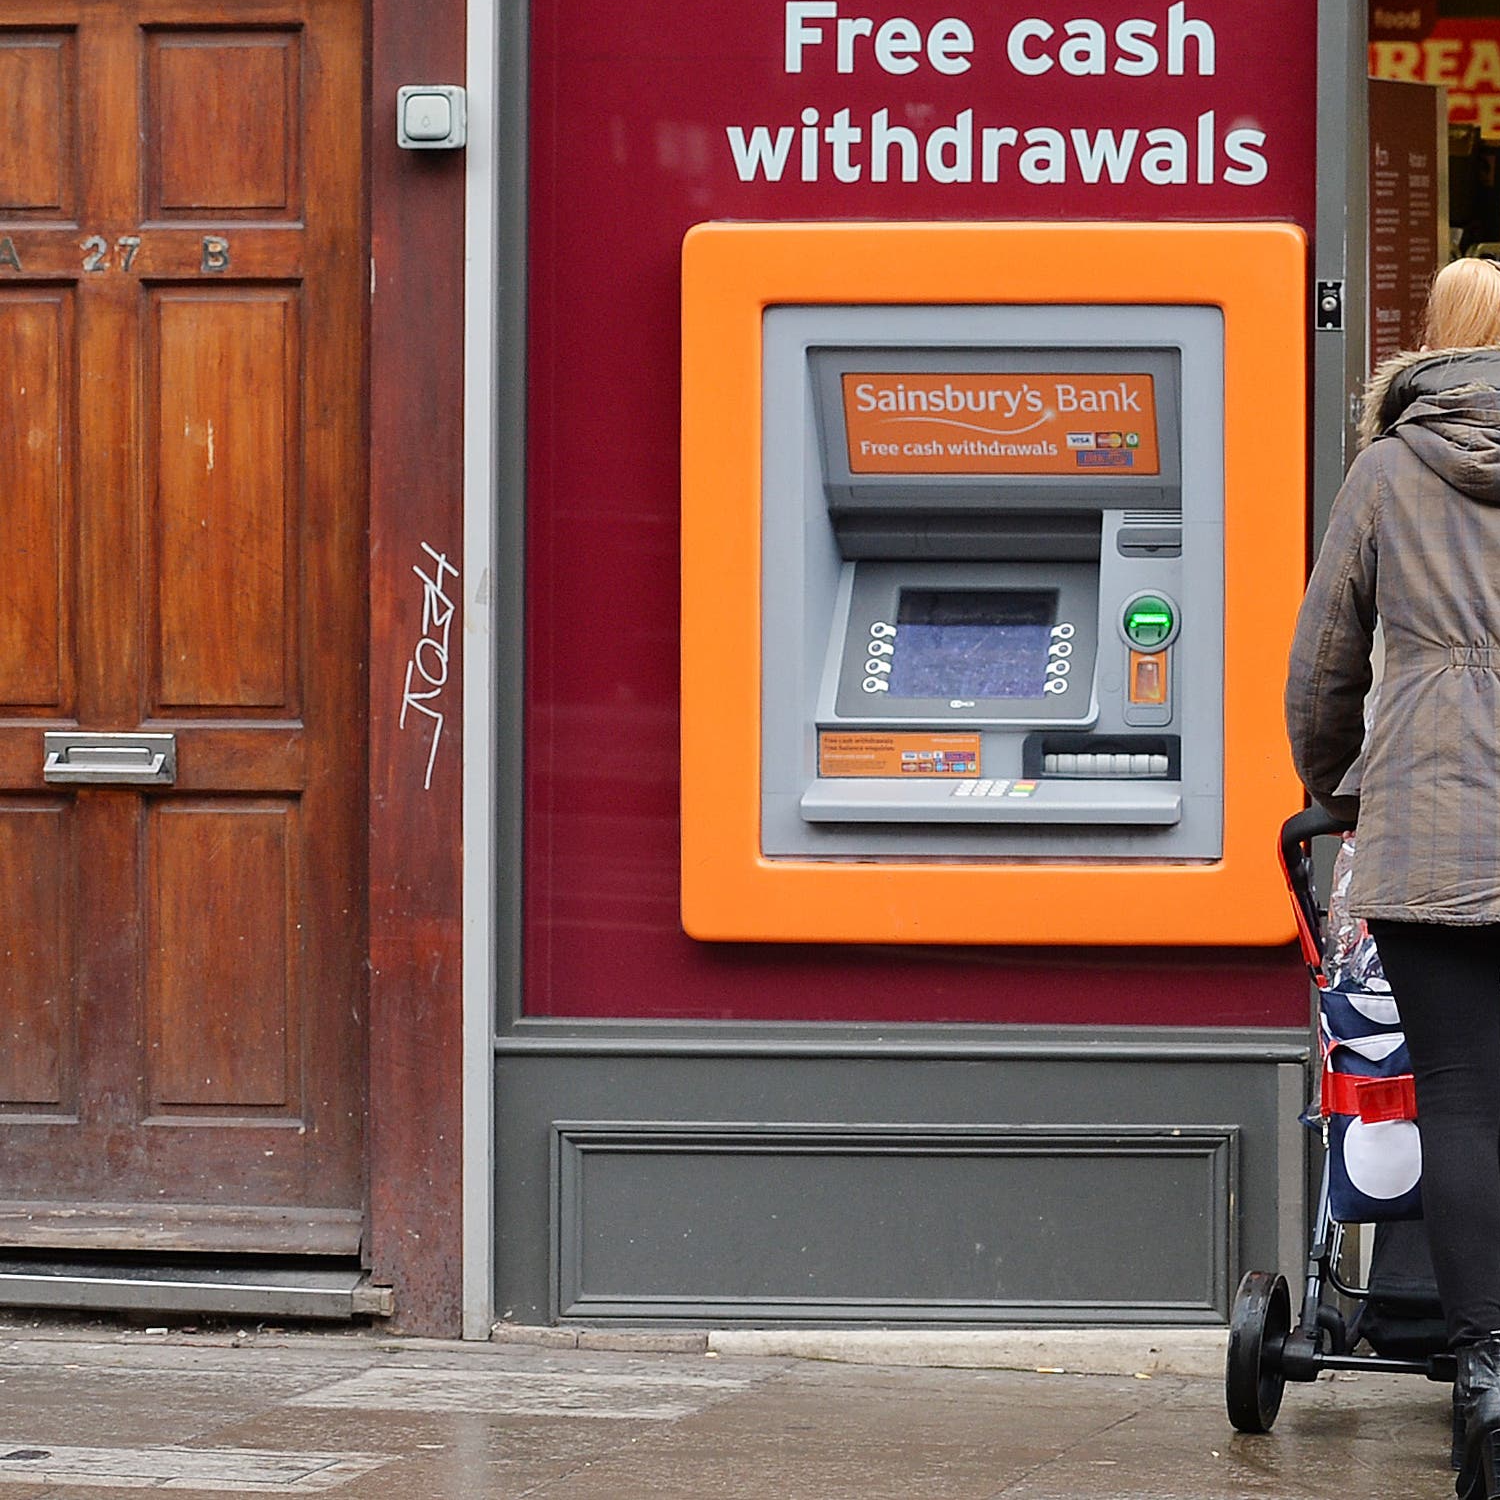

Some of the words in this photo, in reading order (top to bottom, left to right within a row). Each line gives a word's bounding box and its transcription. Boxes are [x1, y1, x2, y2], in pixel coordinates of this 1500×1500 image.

[784, 0, 975, 76] Free
[1006, 0, 1217, 77] cash
[726, 106, 1268, 186] withdrawals
[0, 236, 22, 272] A
[79, 234, 142, 273] 27
[200, 235, 231, 273] B
[855, 383, 1043, 418] Sainsbury's
[1055, 381, 1142, 413] Bank
[860, 440, 899, 456] Free
[903, 440, 944, 456] cash
[947, 439, 1058, 457] withdrawals
